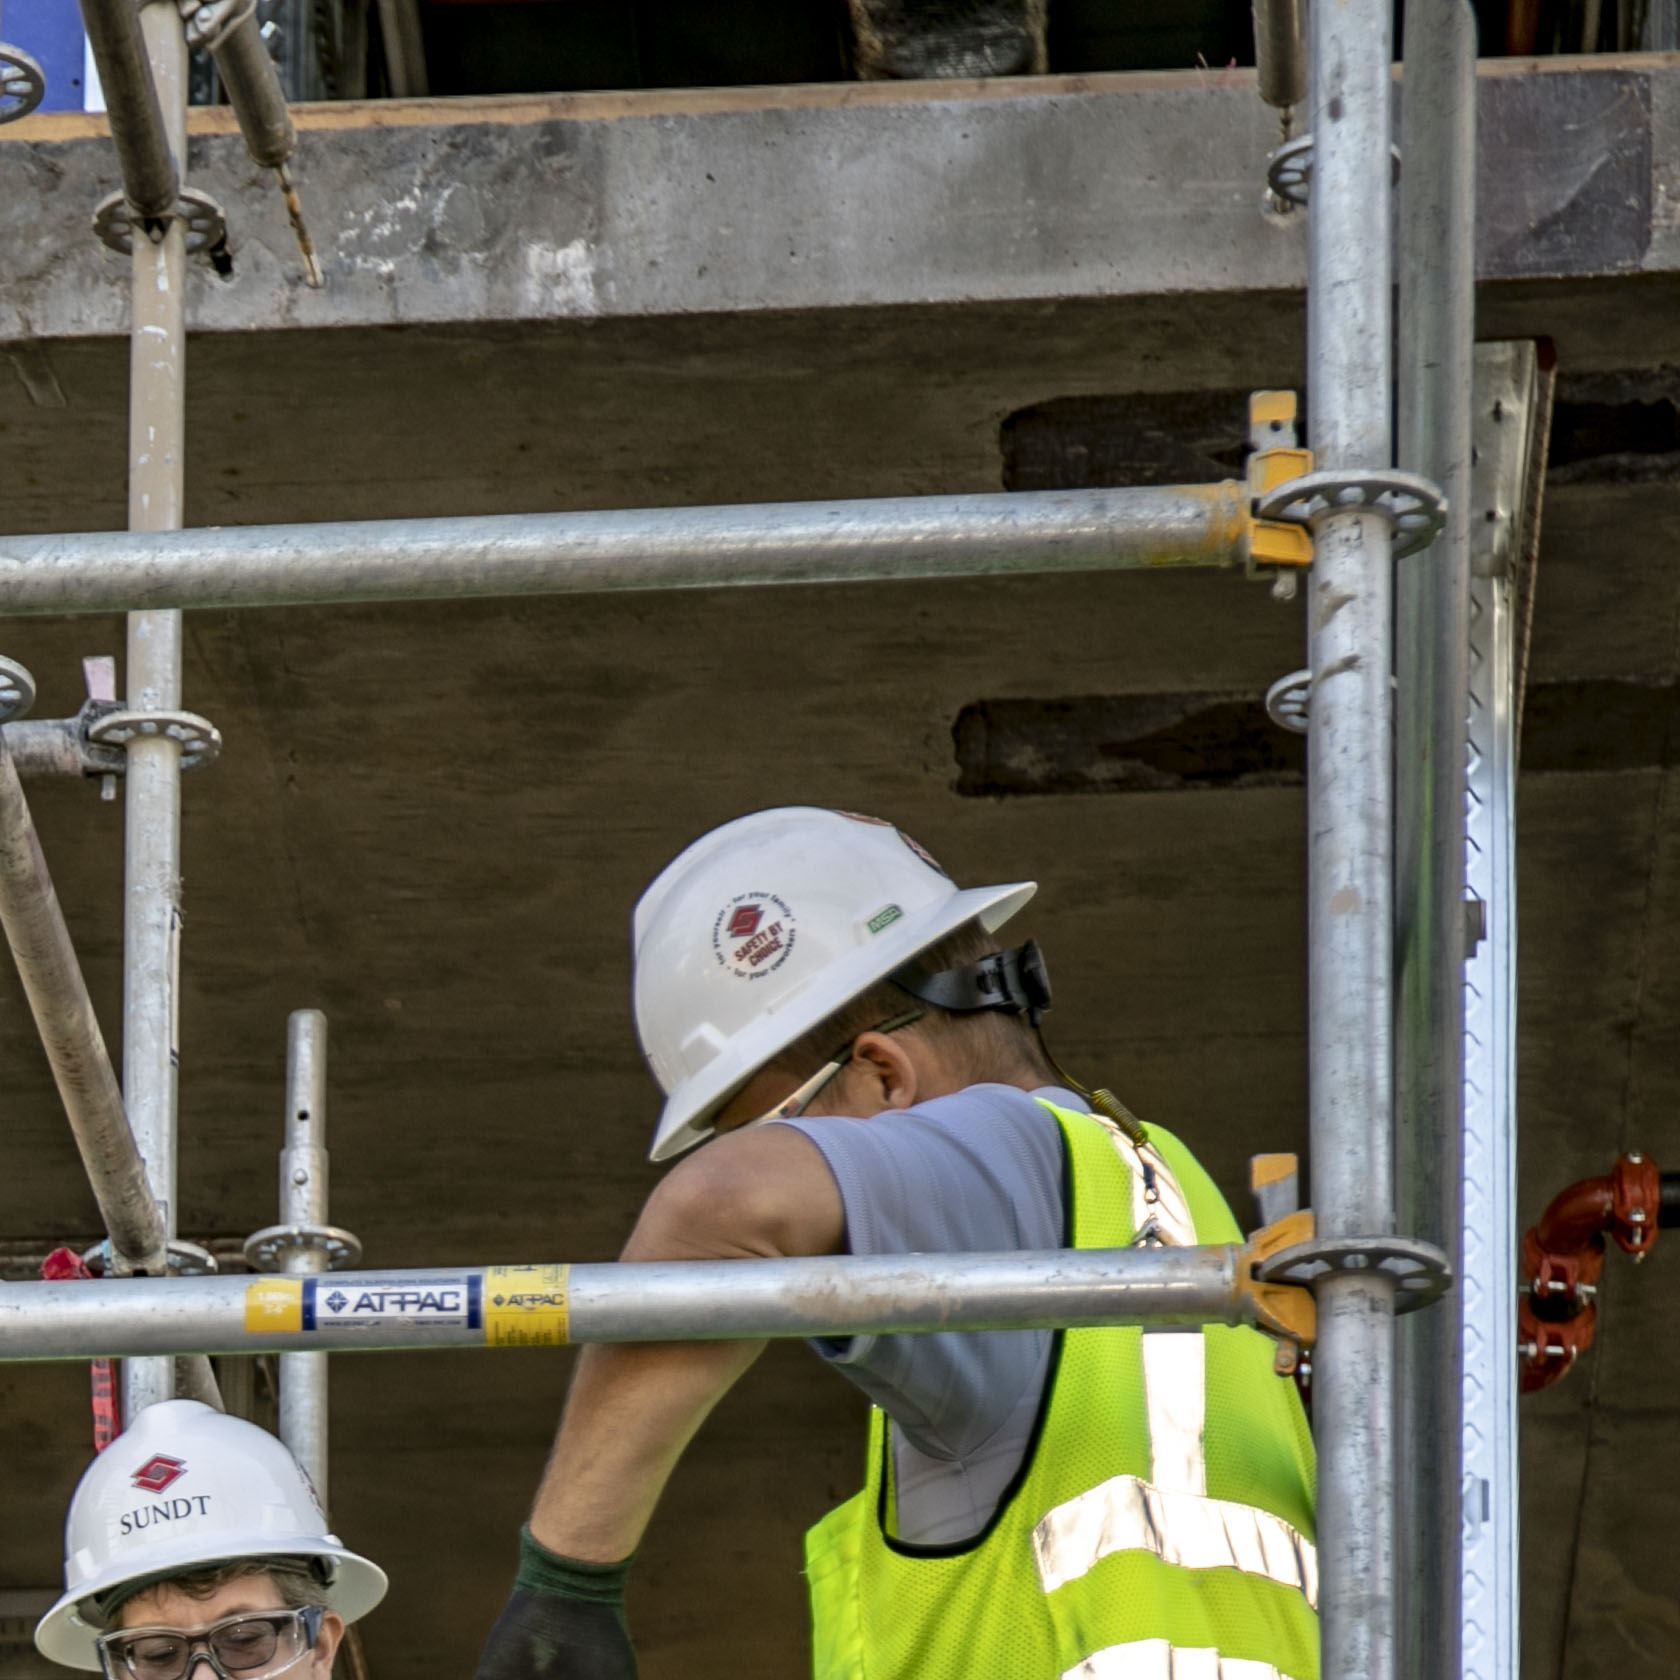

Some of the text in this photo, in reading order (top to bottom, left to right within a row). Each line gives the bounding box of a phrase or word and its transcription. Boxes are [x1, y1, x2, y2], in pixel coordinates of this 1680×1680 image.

[868, 906, 902, 932] MSA
[734, 919, 784, 962] SAFETY BY
[748, 936, 784, 967] CHOICE
[120, 1495, 211, 1535] SUNDT
